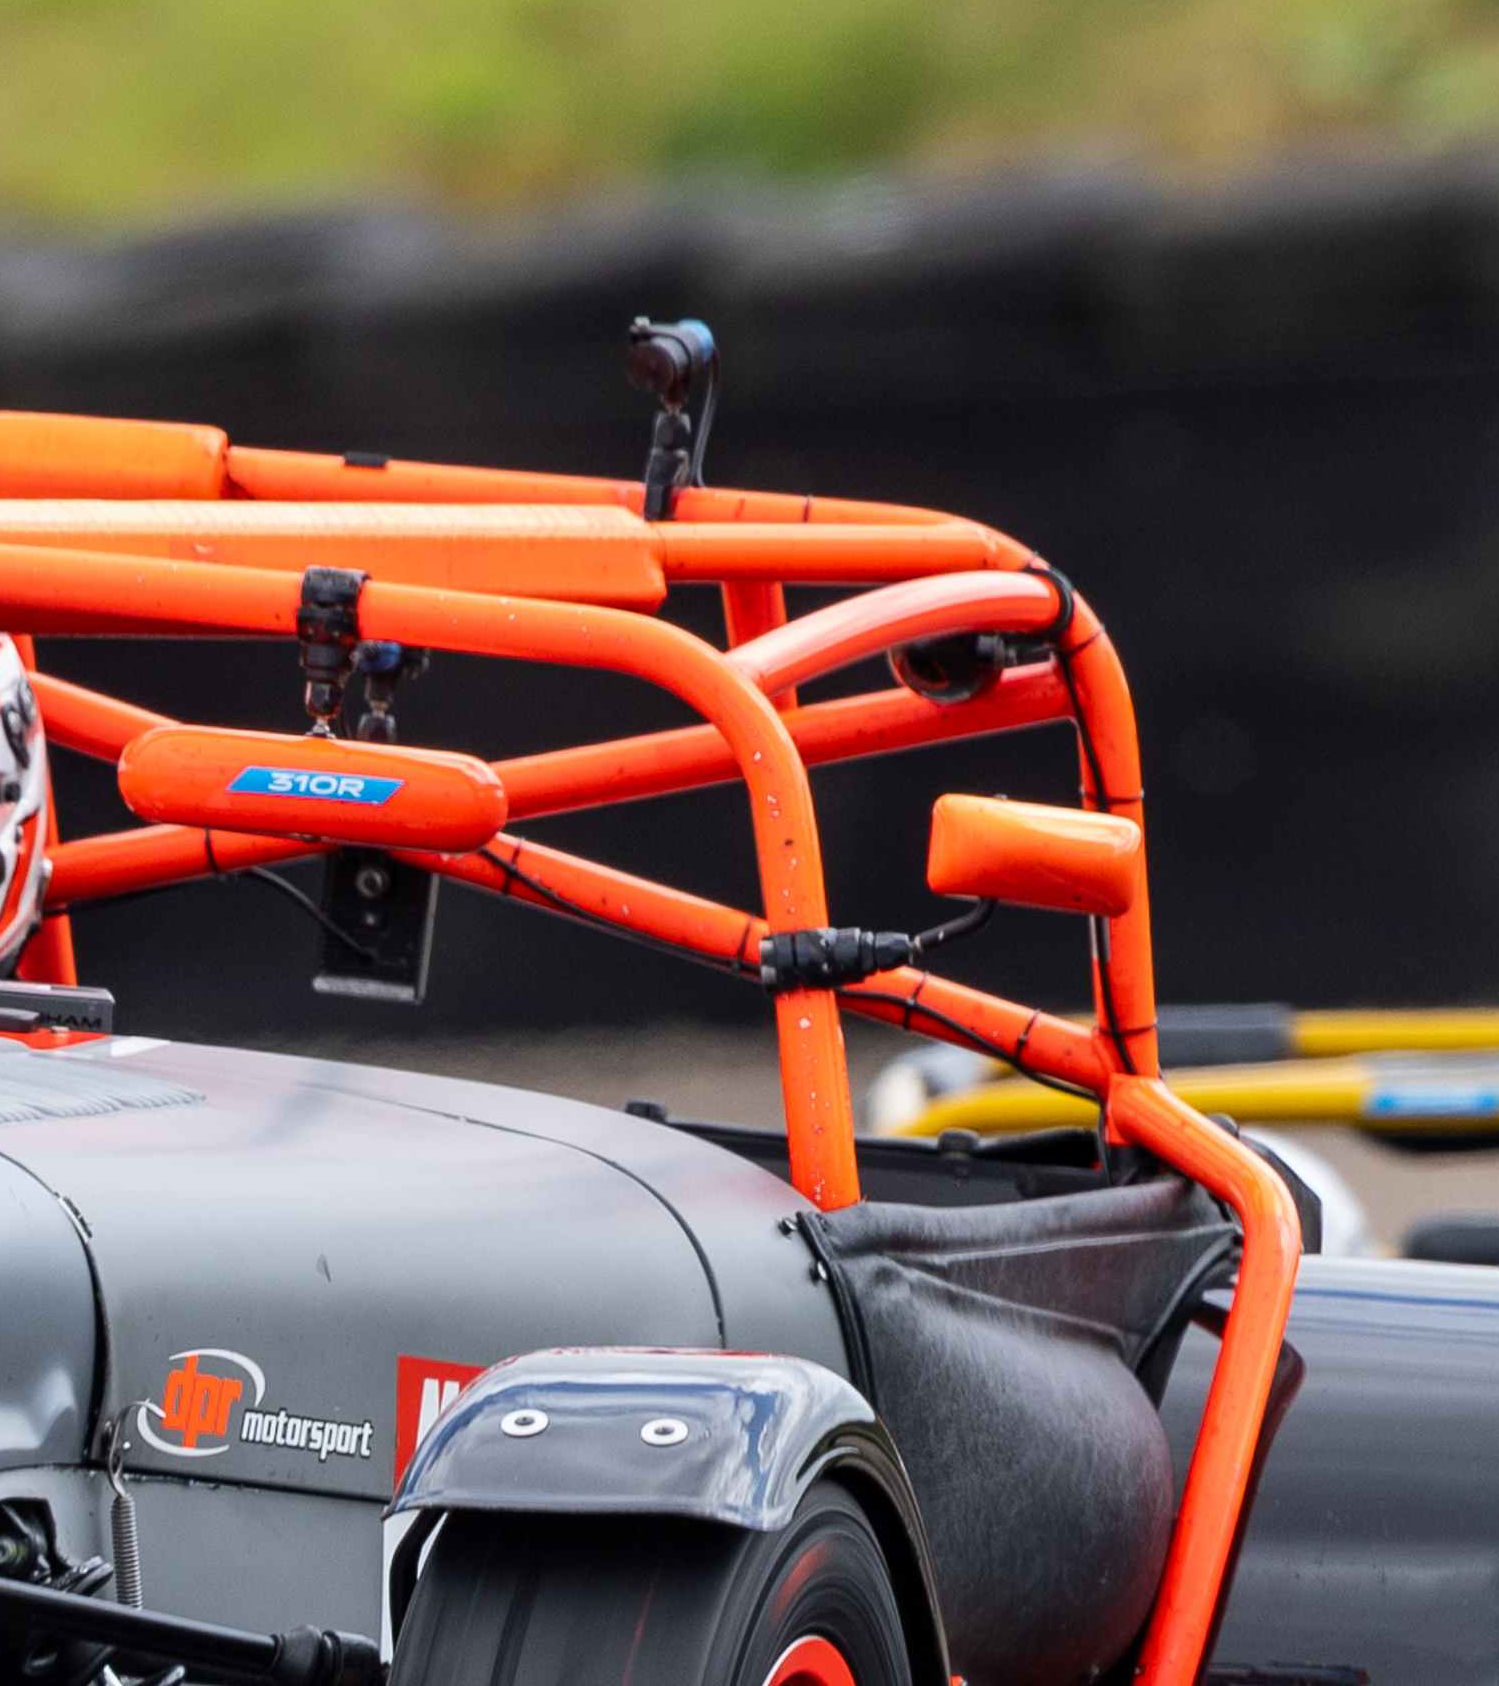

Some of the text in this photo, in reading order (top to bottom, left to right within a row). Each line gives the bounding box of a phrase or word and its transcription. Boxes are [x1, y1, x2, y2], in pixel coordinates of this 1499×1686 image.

[267, 771, 366, 798] 310R
[161, 1353, 244, 1449] dpr
[240, 1407, 375, 1461] motorsport
